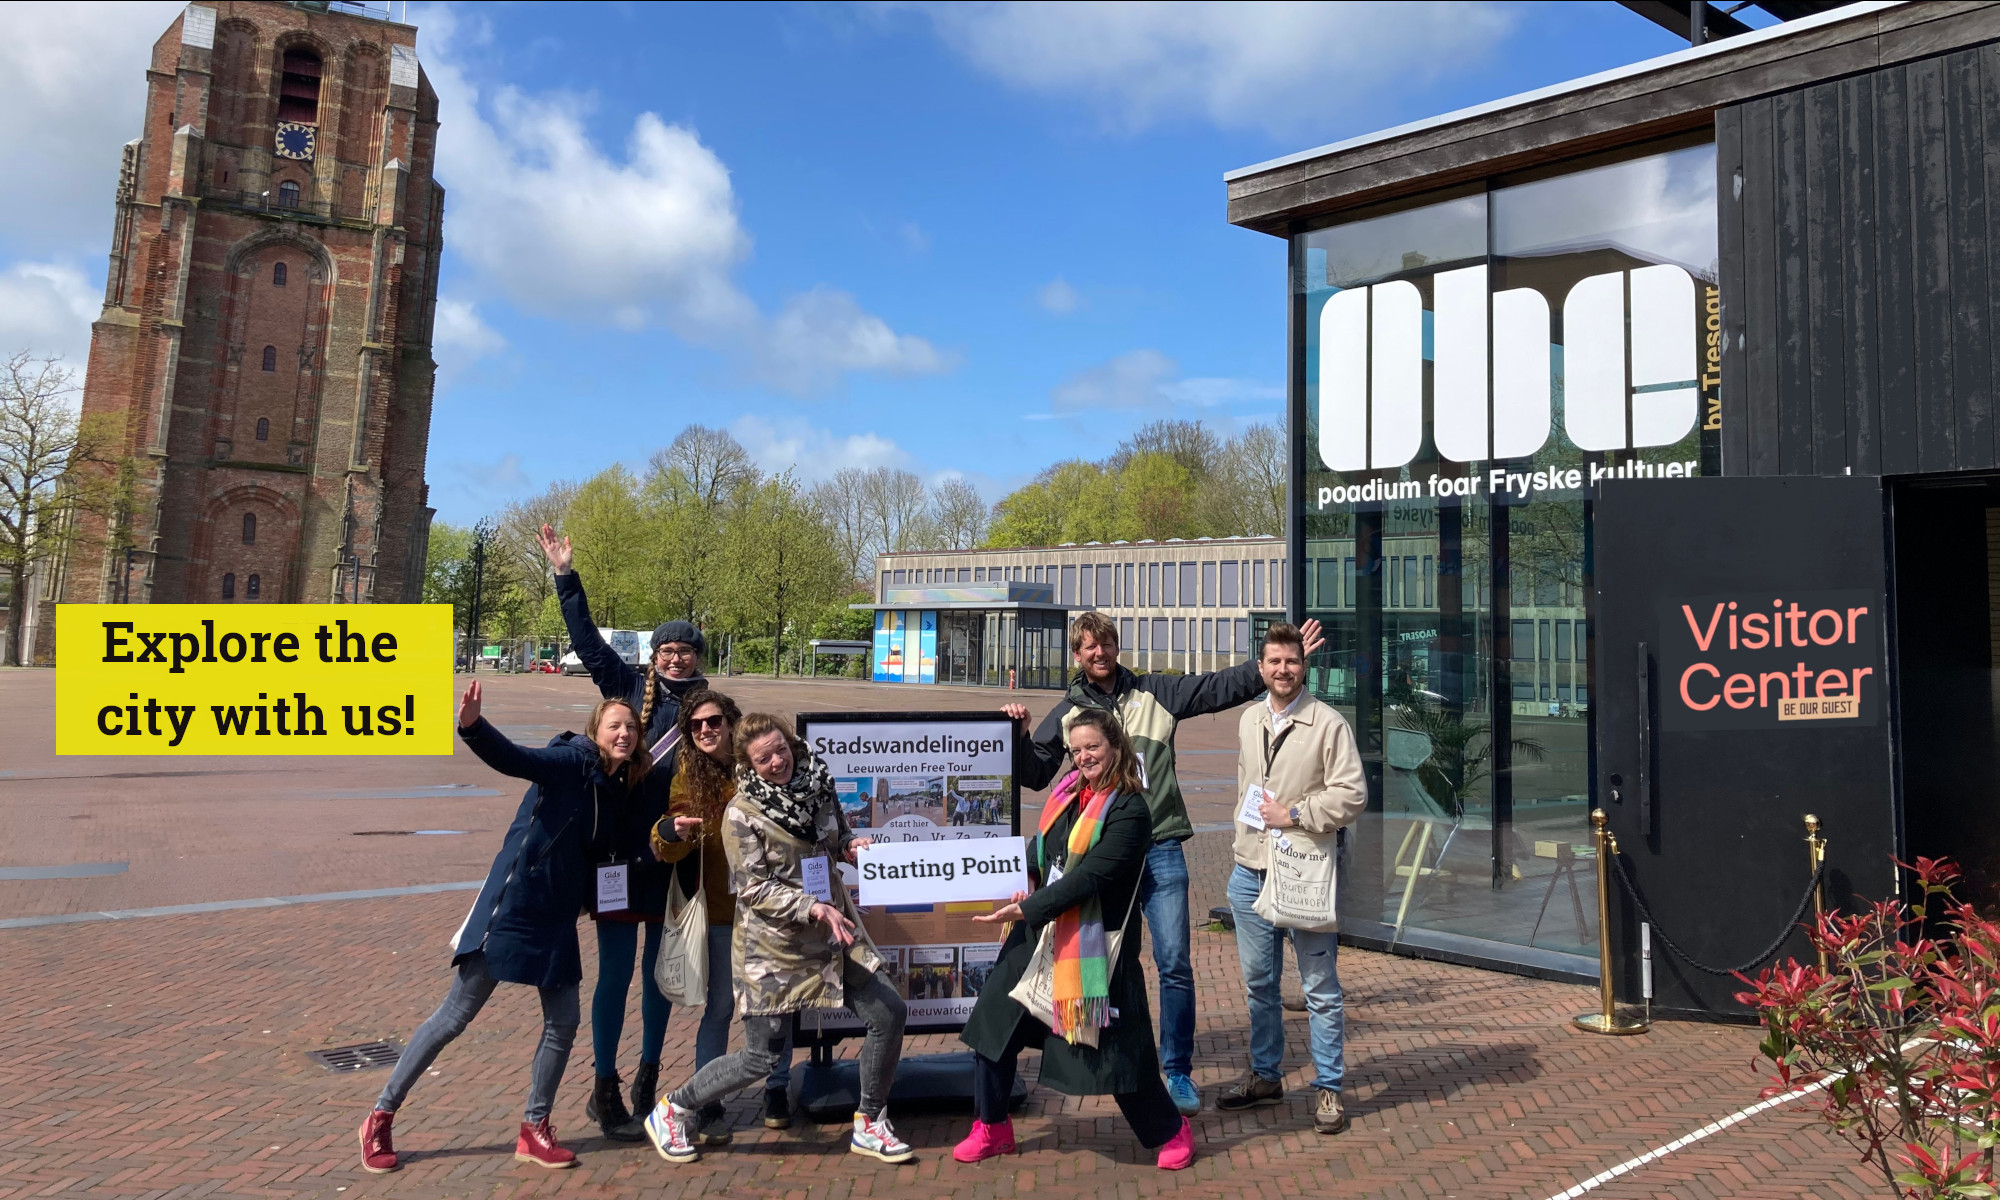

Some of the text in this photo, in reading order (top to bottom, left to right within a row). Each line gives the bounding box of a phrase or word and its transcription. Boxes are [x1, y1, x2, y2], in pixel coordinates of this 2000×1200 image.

[1318, 458, 1698, 510] poadium foar Fryske kultuer
[1681, 598, 1868, 652] Visitor
[1679, 661, 1873, 712] Center
[1784, 700, 1853, 716] BE OUR GUEST
[814, 734, 1005, 758] Stadswandelingen
[847, 762, 973, 774] Leeuwarden Free Tour
[890, 819, 929, 828] start hier
[871, 833, 891, 844] Wo
[903, 833, 919, 842] Do
[931, 832, 946, 841] Vr
[1309, 852, 1328, 862] me!
[807, 862, 823, 871] Gids
[863, 855, 1022, 881] Starting Point
[1277, 858, 1290, 869] am
[604, 871, 621, 879] Gids
[1313, 886, 1326, 896] TO
[1276, 890, 1327, 908] EEUWARDEN
